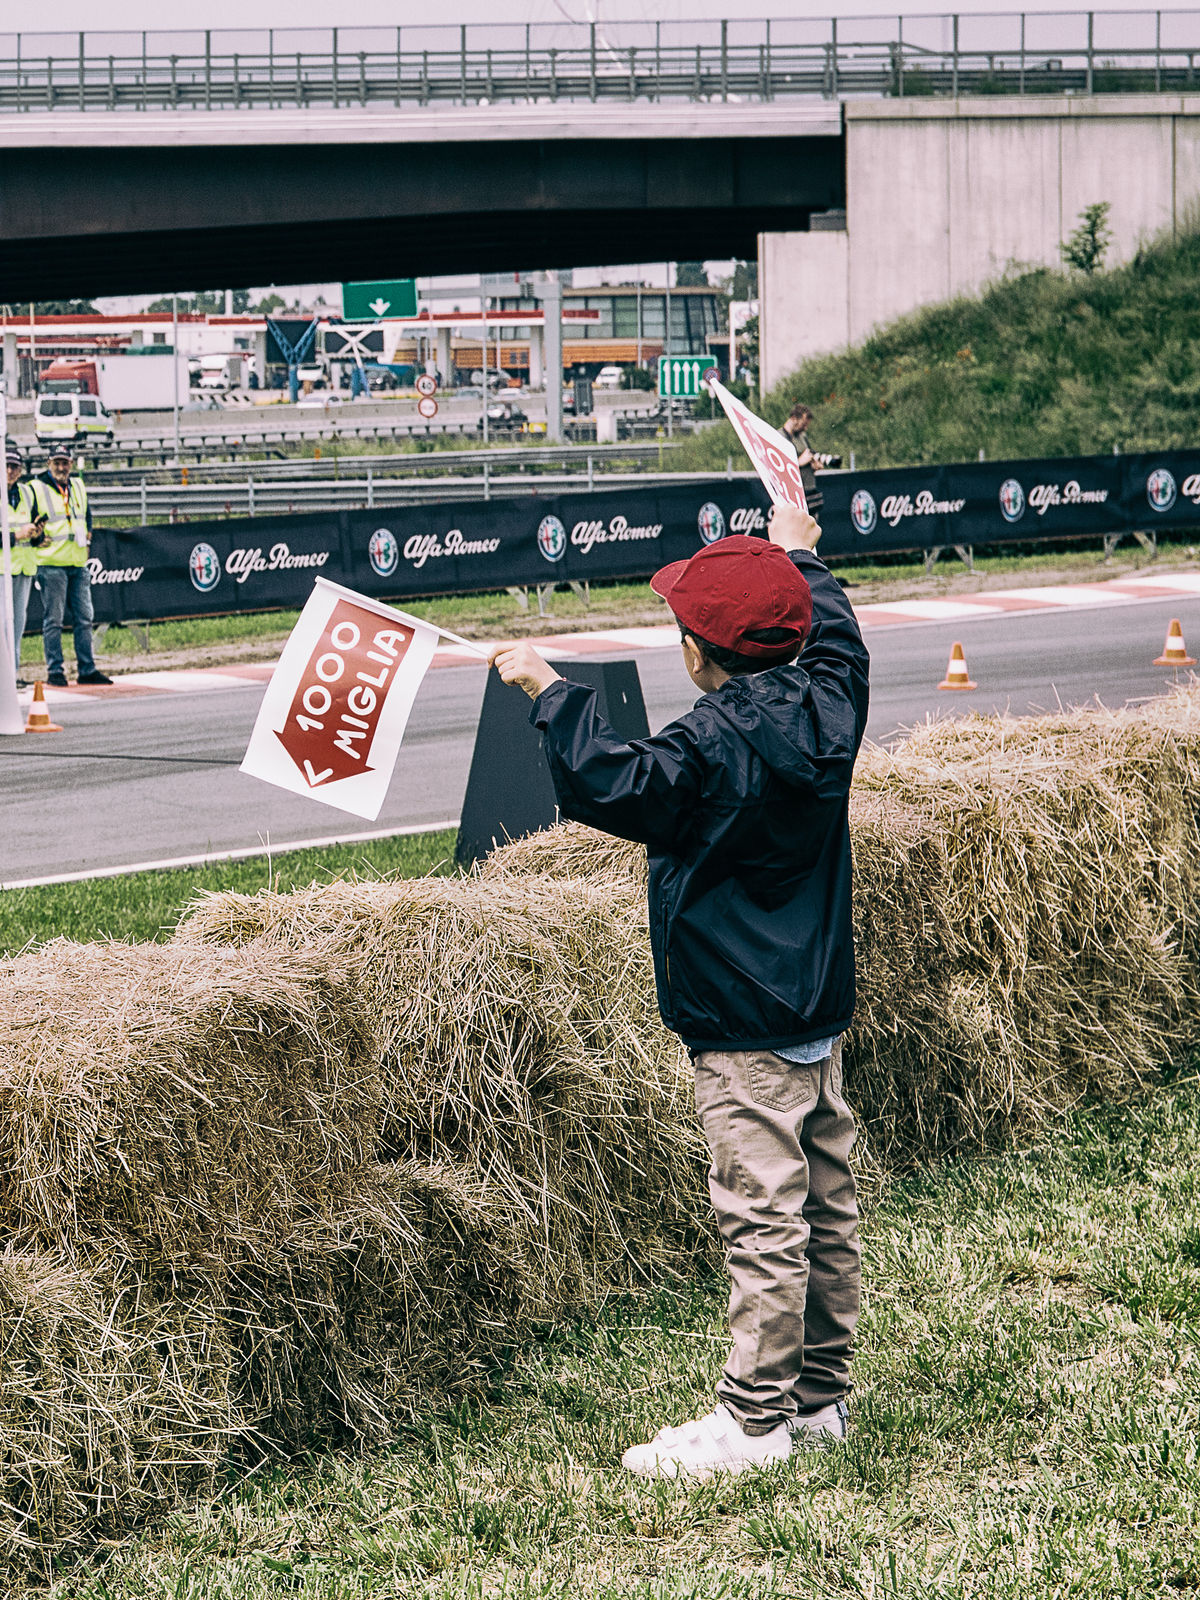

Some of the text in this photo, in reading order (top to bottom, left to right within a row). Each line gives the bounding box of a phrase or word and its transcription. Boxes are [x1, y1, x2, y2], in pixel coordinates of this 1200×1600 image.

[881, 495, 916, 527] Alfa
[914, 490, 966, 515] Romeo
[1028, 484, 1063, 516] Alfa
[571, 520, 609, 554] Alfa
[607, 515, 663, 542] Romeo
[730, 507, 765, 536] Alfa
[225, 547, 270, 583] Alfa
[268, 542, 329, 570] Romeo
[403, 534, 444, 568] Alfa
[442, 529, 500, 556] Romeo
[296, 621, 361, 732] 1000
[333, 629, 406, 760] MIGLIA
